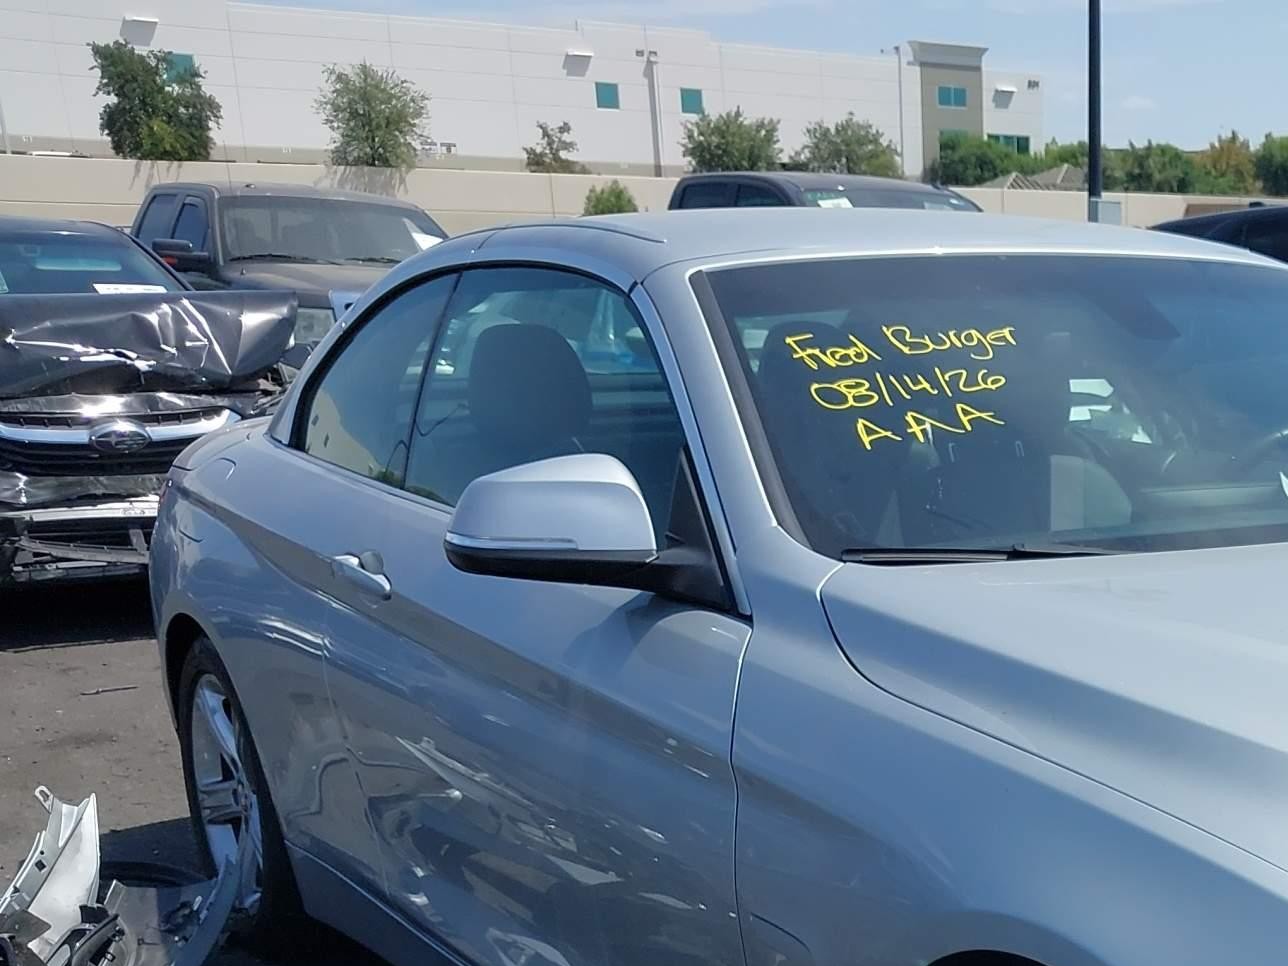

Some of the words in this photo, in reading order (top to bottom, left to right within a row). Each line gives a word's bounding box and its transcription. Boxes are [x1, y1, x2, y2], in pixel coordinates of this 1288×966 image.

[785, 333, 882, 370] Fred
[881, 325, 1017, 361] Burger
[810, 366, 1007, 410] 08/14/26
